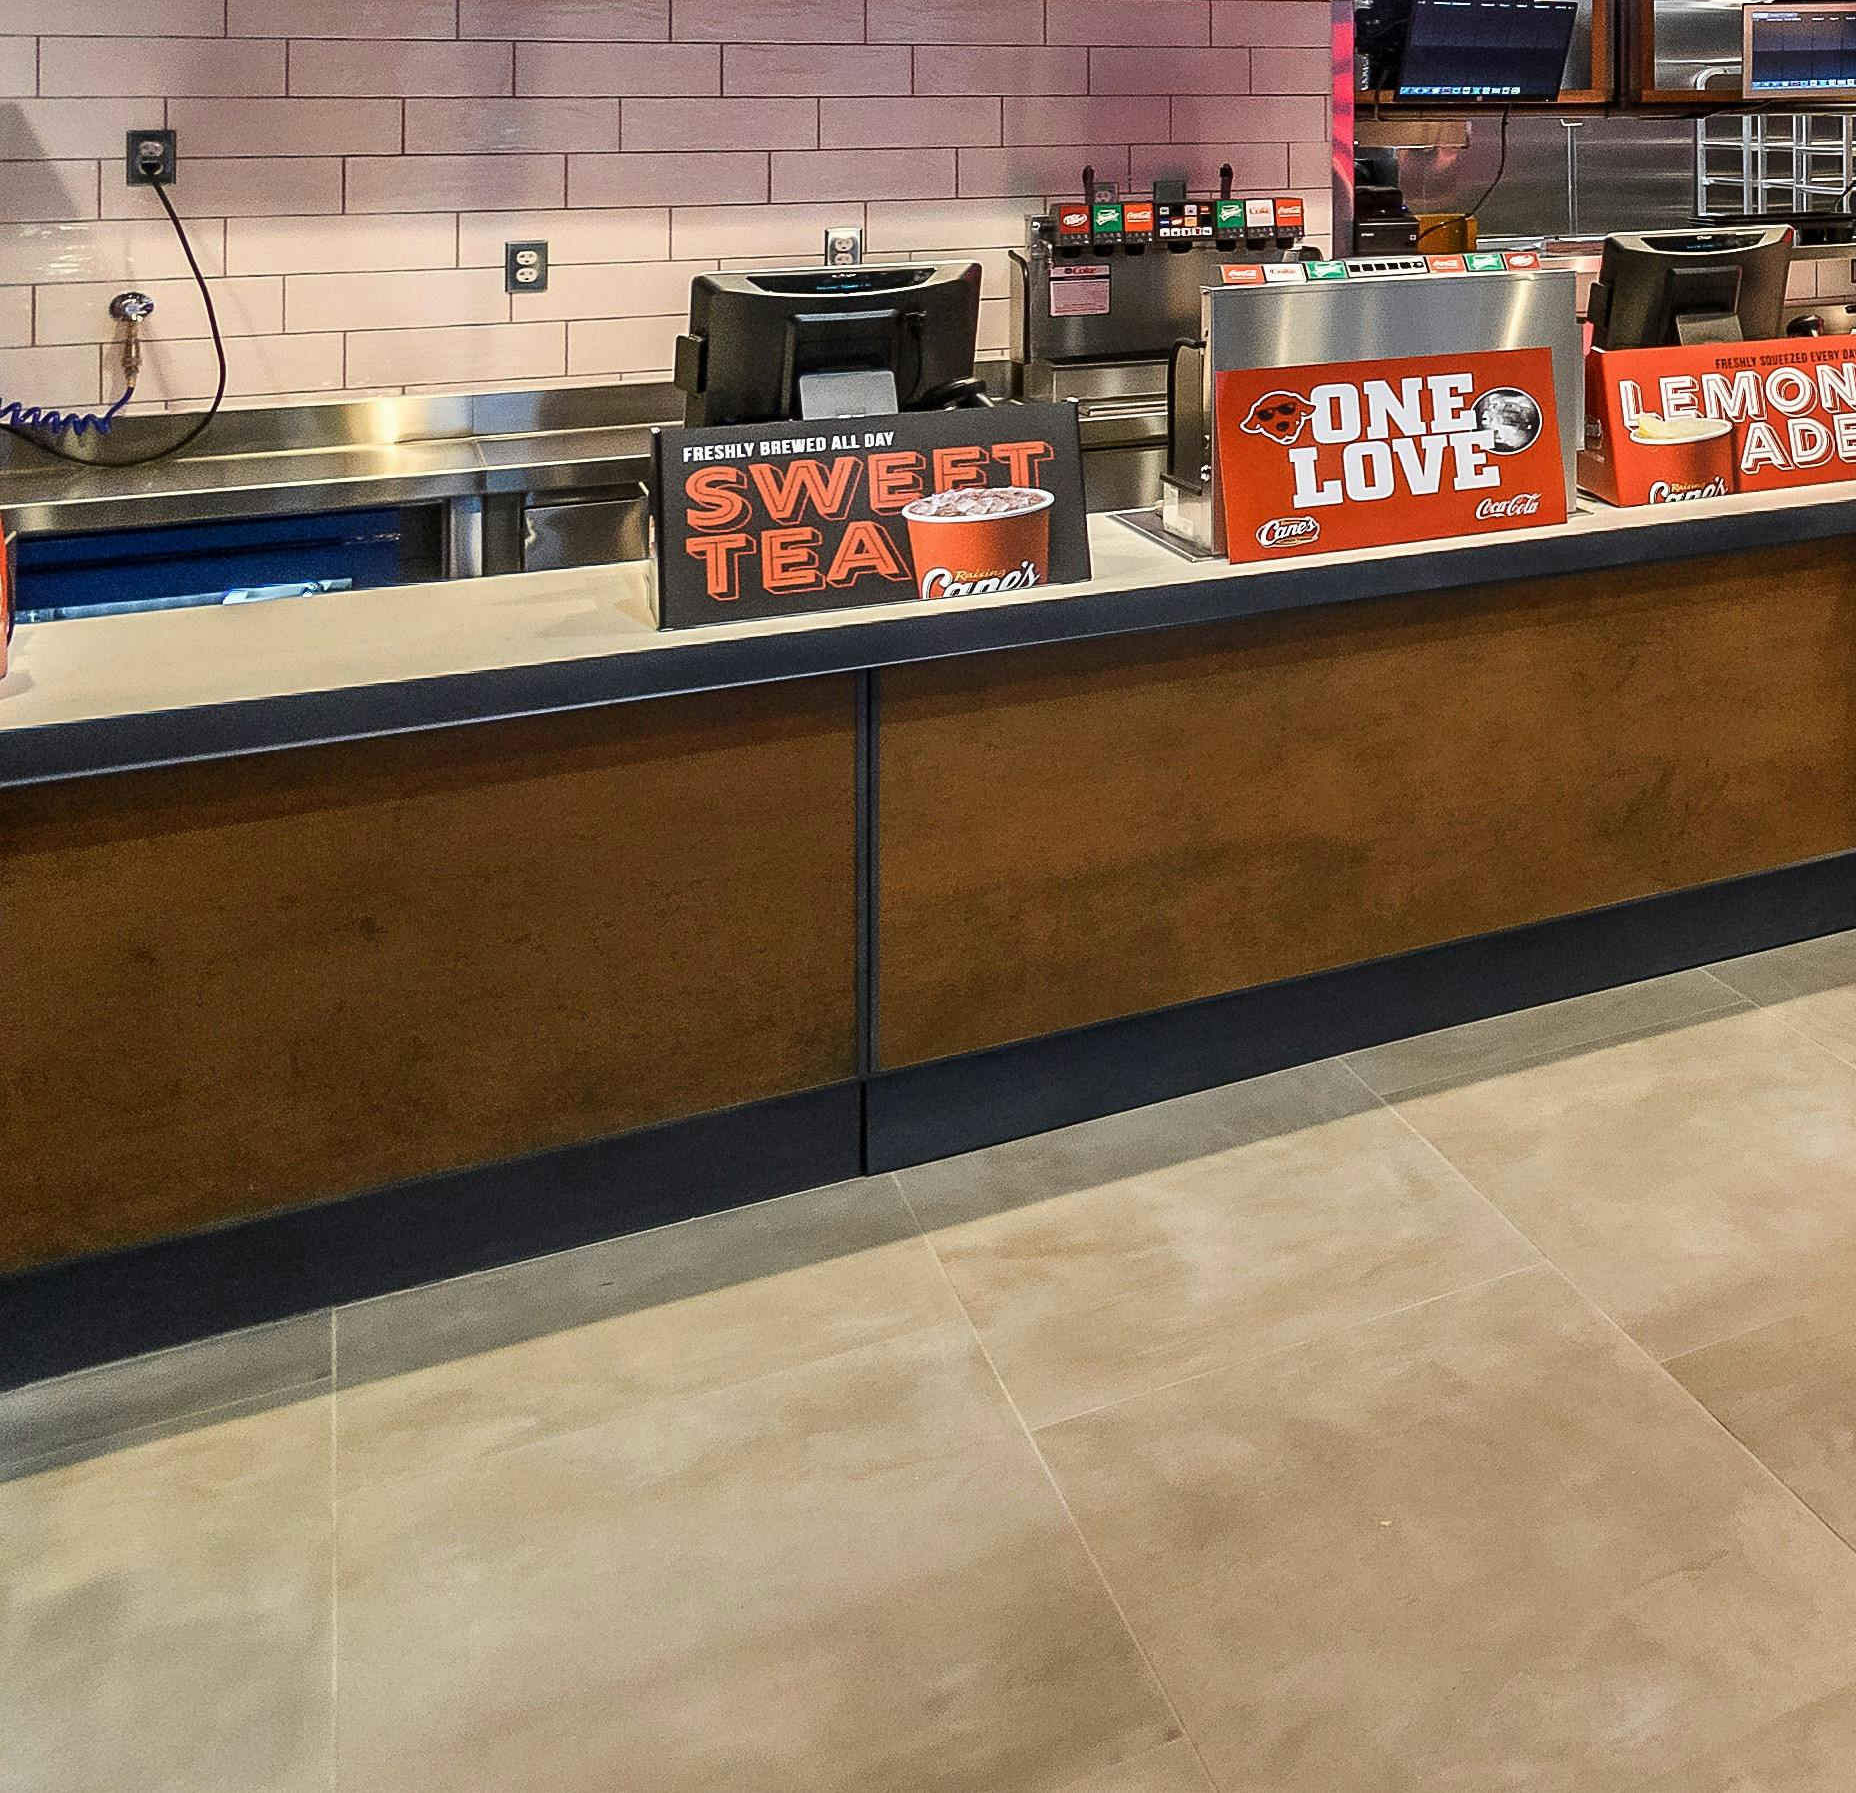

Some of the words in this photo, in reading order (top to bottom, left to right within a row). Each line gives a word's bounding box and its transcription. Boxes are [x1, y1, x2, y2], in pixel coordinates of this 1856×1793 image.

[1715, 356, 1757, 369] FRESHLY
[1760, 353, 1808, 366] SQUEEZED
[1811, 350, 1840, 363] EVERY
[1310, 373, 1479, 444] ONE
[683, 445, 754, 463] FRESHLY
[760, 437, 827, 456] BREWED
[831, 433, 861, 451] ALL
[864, 431, 895, 448] DAY
[685, 440, 1054, 532] SWEET
[1289, 429, 1500, 509] LOVE
[1475, 493, 1543, 520] Coca-Cola
[1259, 516, 1317, 547] Cane's
[686, 520, 911, 601] TEA
[955, 568, 1005, 582] Raising
[922, 560, 1040, 600] Cane's
